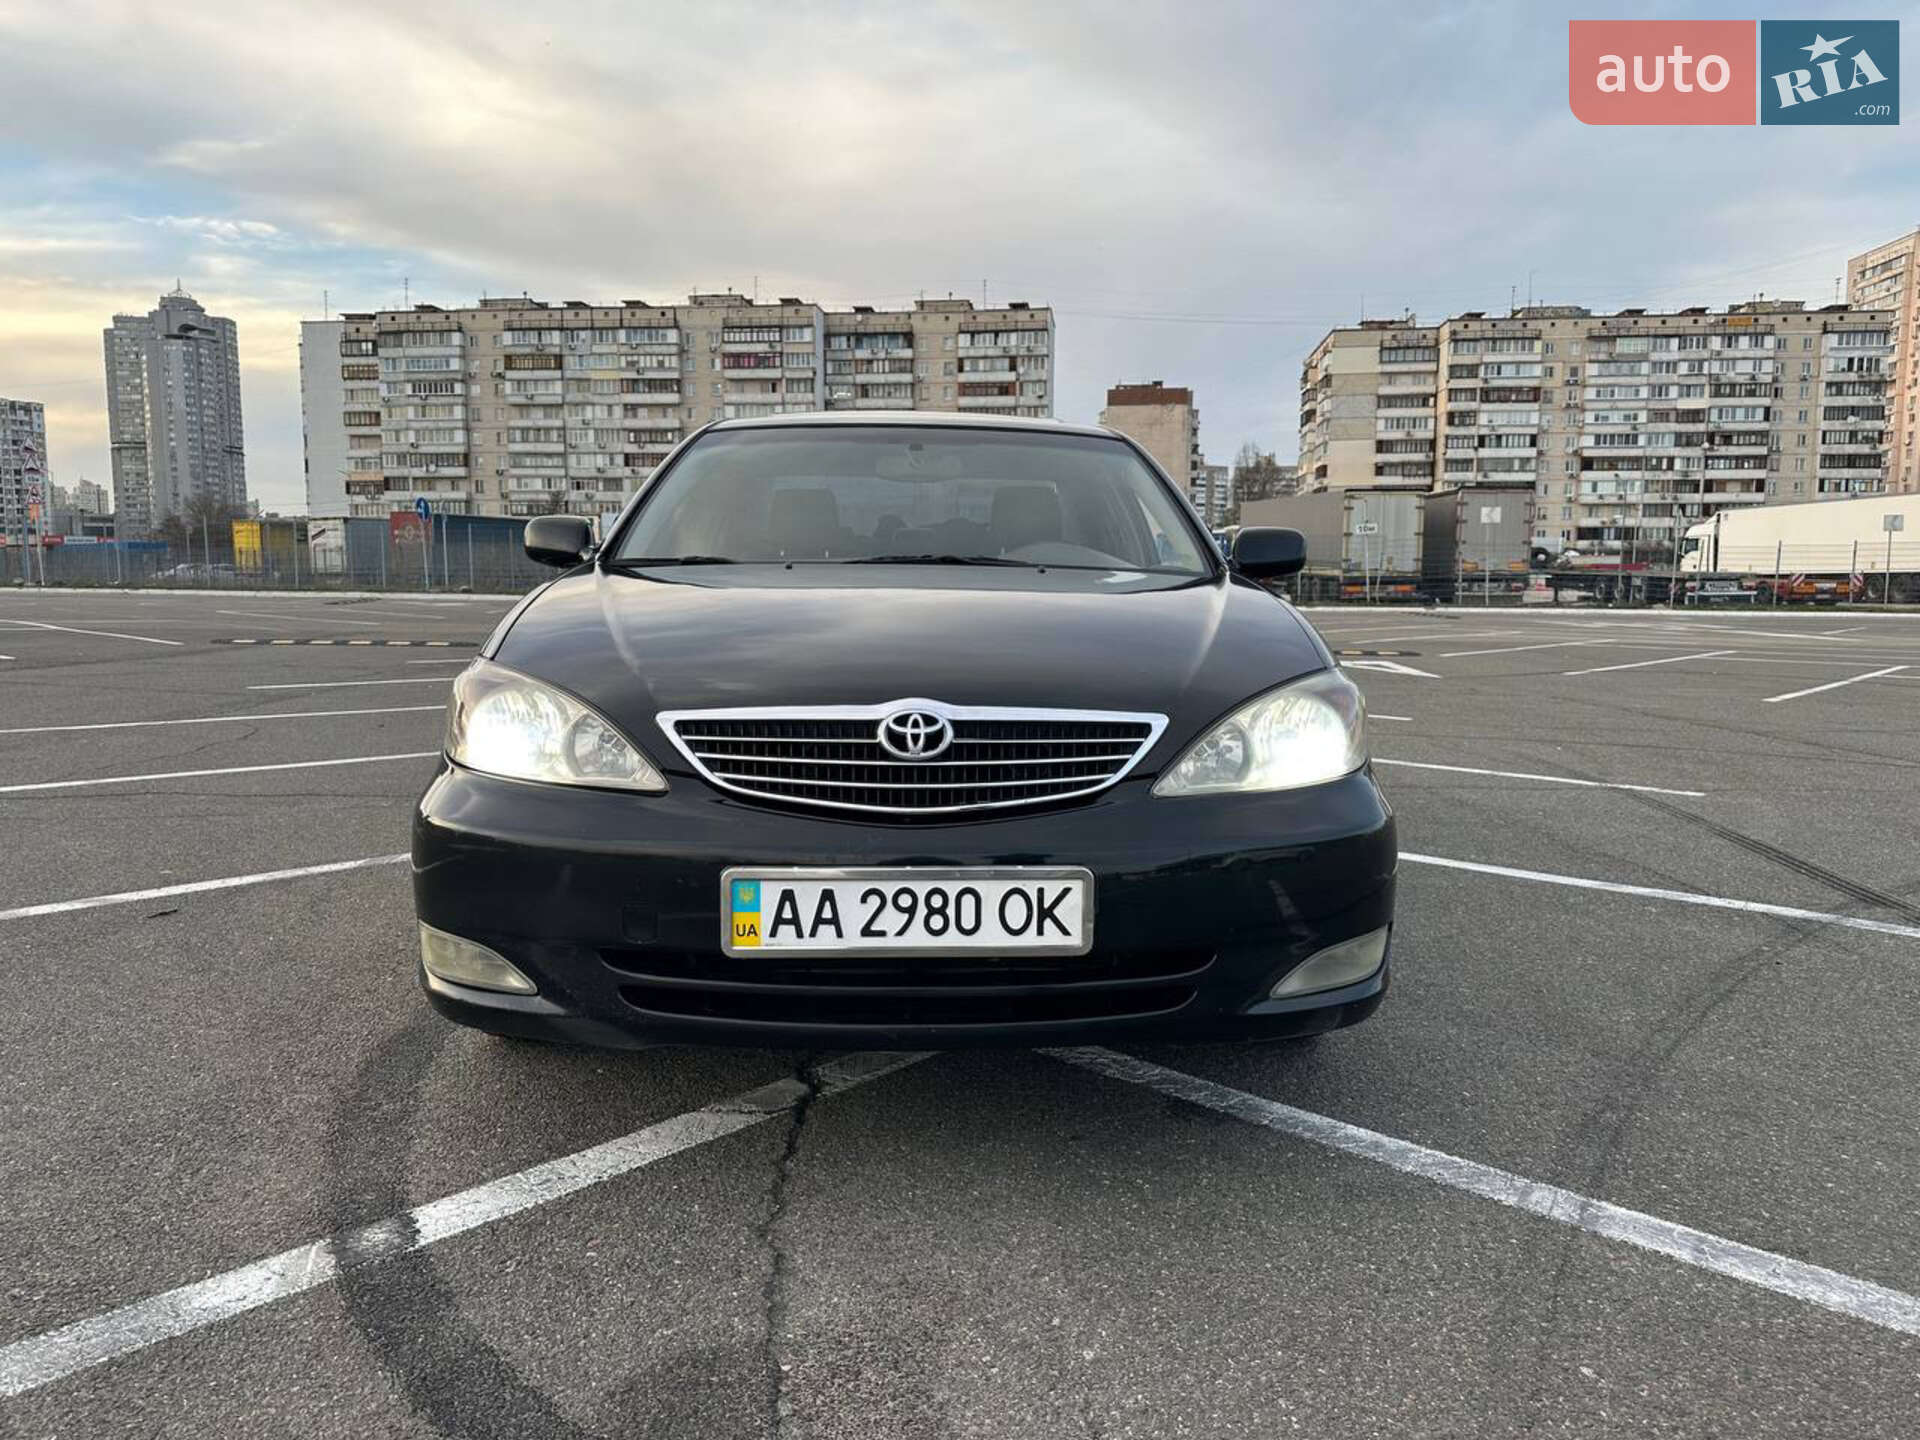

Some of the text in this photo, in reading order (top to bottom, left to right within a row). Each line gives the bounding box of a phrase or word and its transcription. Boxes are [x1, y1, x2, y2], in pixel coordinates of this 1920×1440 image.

[769, 886, 1073, 938] AA 2980 OK
[735, 924, 757, 937] UA
